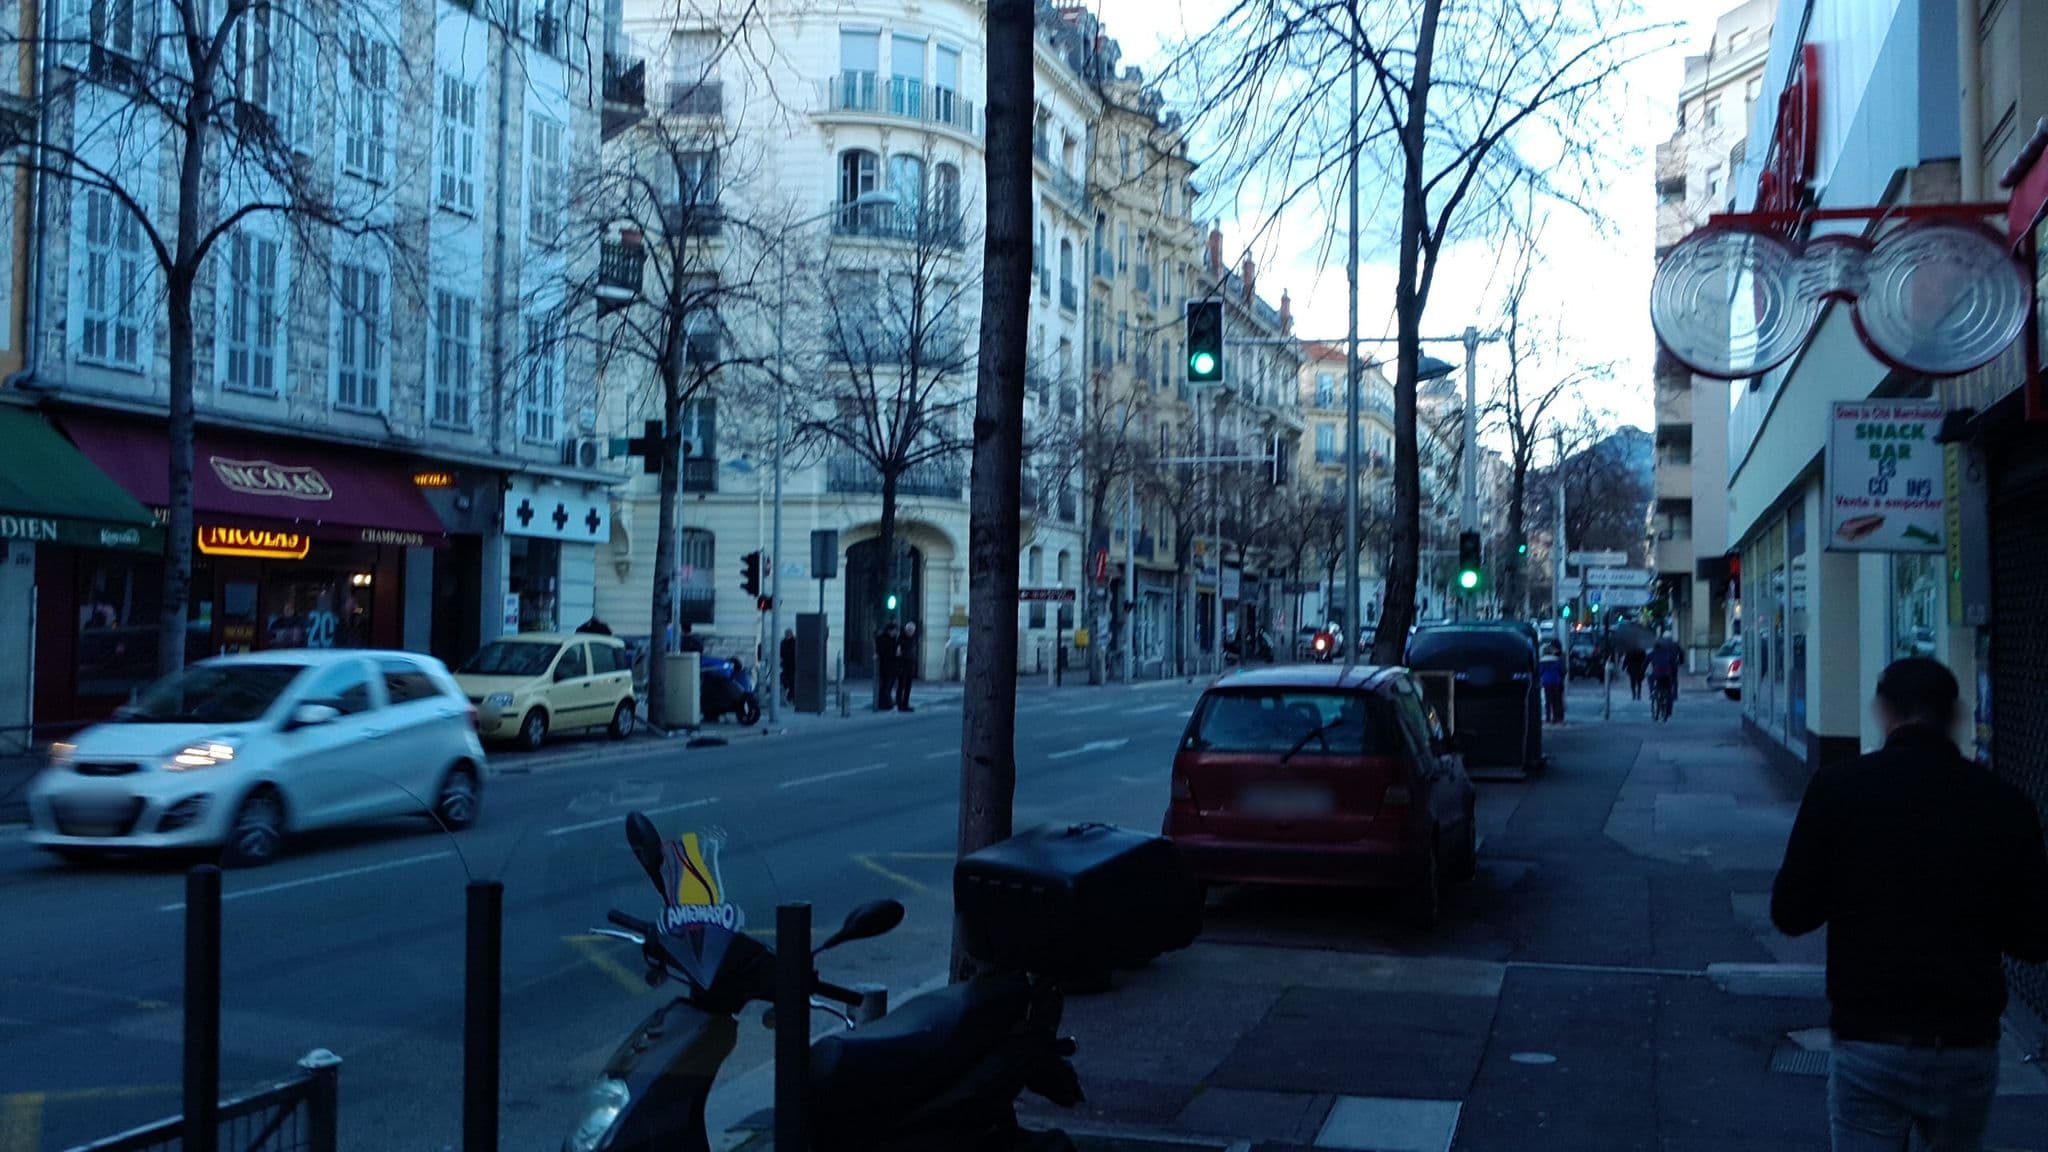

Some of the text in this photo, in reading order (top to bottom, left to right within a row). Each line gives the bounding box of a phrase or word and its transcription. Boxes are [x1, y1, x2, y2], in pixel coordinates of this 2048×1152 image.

[1855, 424, 1925, 440] SNACK
[1869, 444, 1910, 459] BAR
[218, 463, 326, 493] NICOLAS
[1836, 496, 1870, 507] Vente
[1885, 498, 1943, 511] emporter
[0, 515, 58, 541] DIEN
[210, 527, 300, 548] NICOLAS
